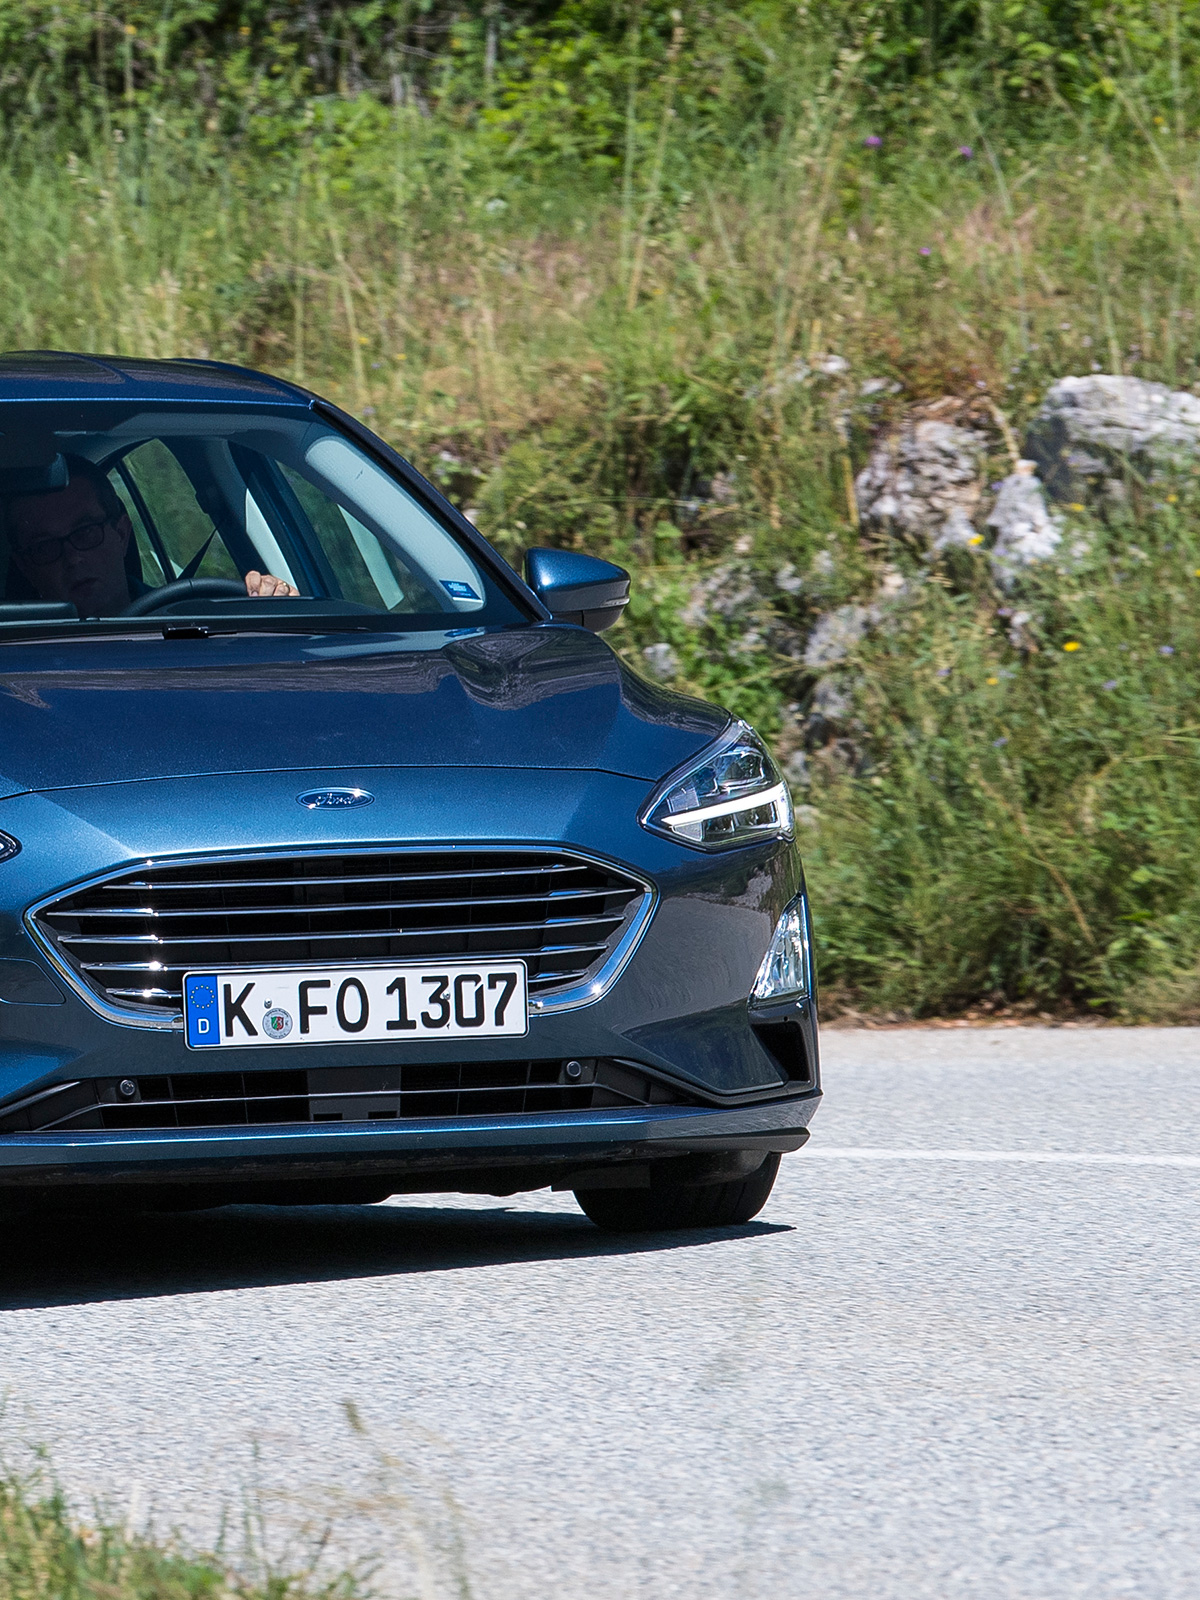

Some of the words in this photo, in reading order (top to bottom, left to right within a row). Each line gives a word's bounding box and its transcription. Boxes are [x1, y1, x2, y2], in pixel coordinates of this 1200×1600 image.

[223, 982, 259, 1037] K
[299, 977, 369, 1034] FO
[386, 972, 518, 1030] 1307
[198, 1018, 210, 1034] D
